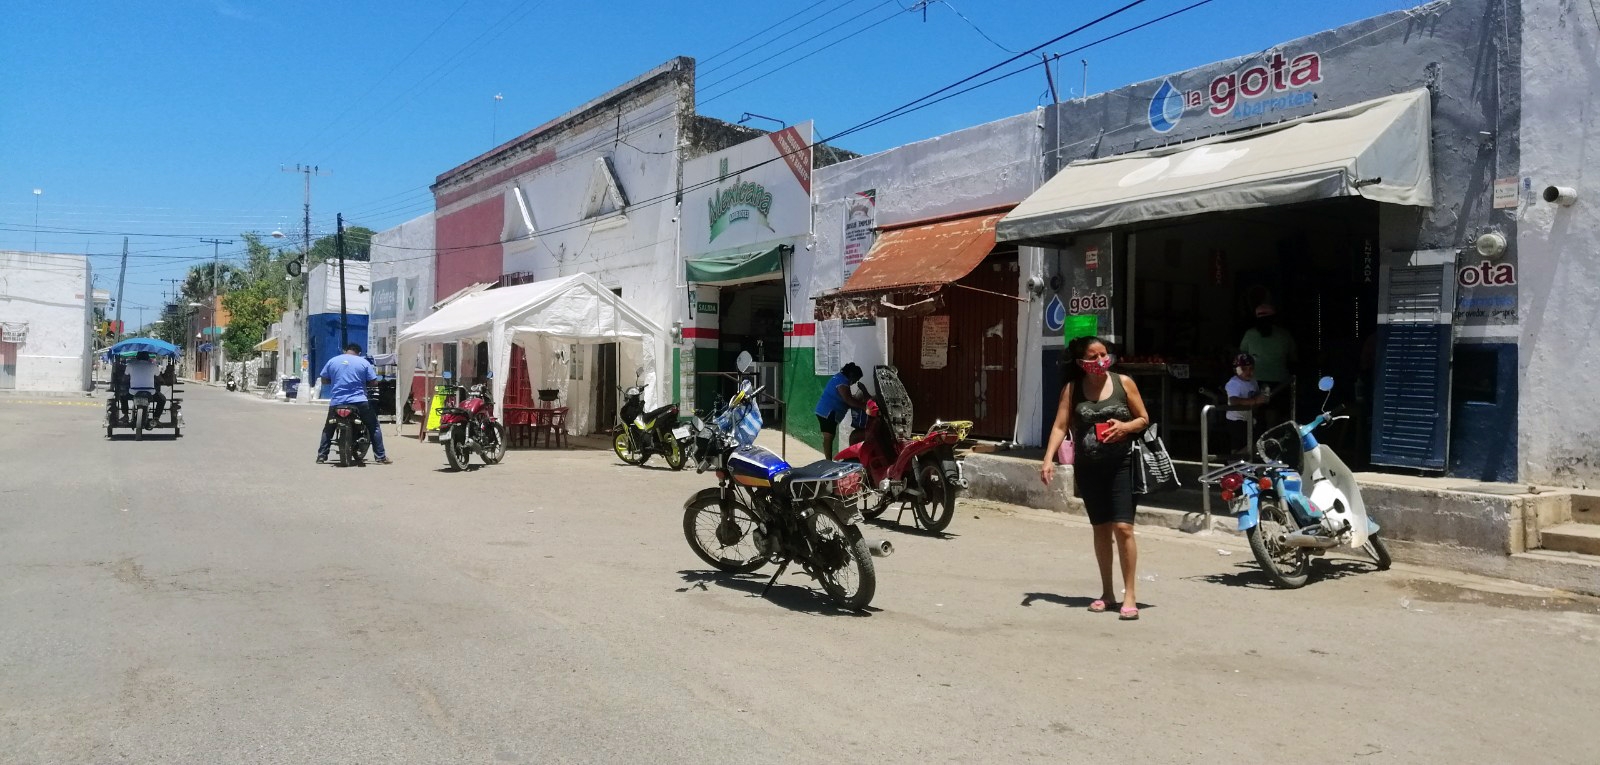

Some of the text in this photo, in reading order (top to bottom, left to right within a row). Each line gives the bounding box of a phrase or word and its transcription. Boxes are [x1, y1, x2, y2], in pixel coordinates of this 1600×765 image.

[1185, 51, 1323, 117] la gota
[1233, 91, 1314, 118] Abarrotes
[707, 175, 773, 228] Mexicana
[1459, 260, 1517, 288] ota
[698, 303, 717, 312] SALIDA
[1069, 292, 1109, 316] gota
